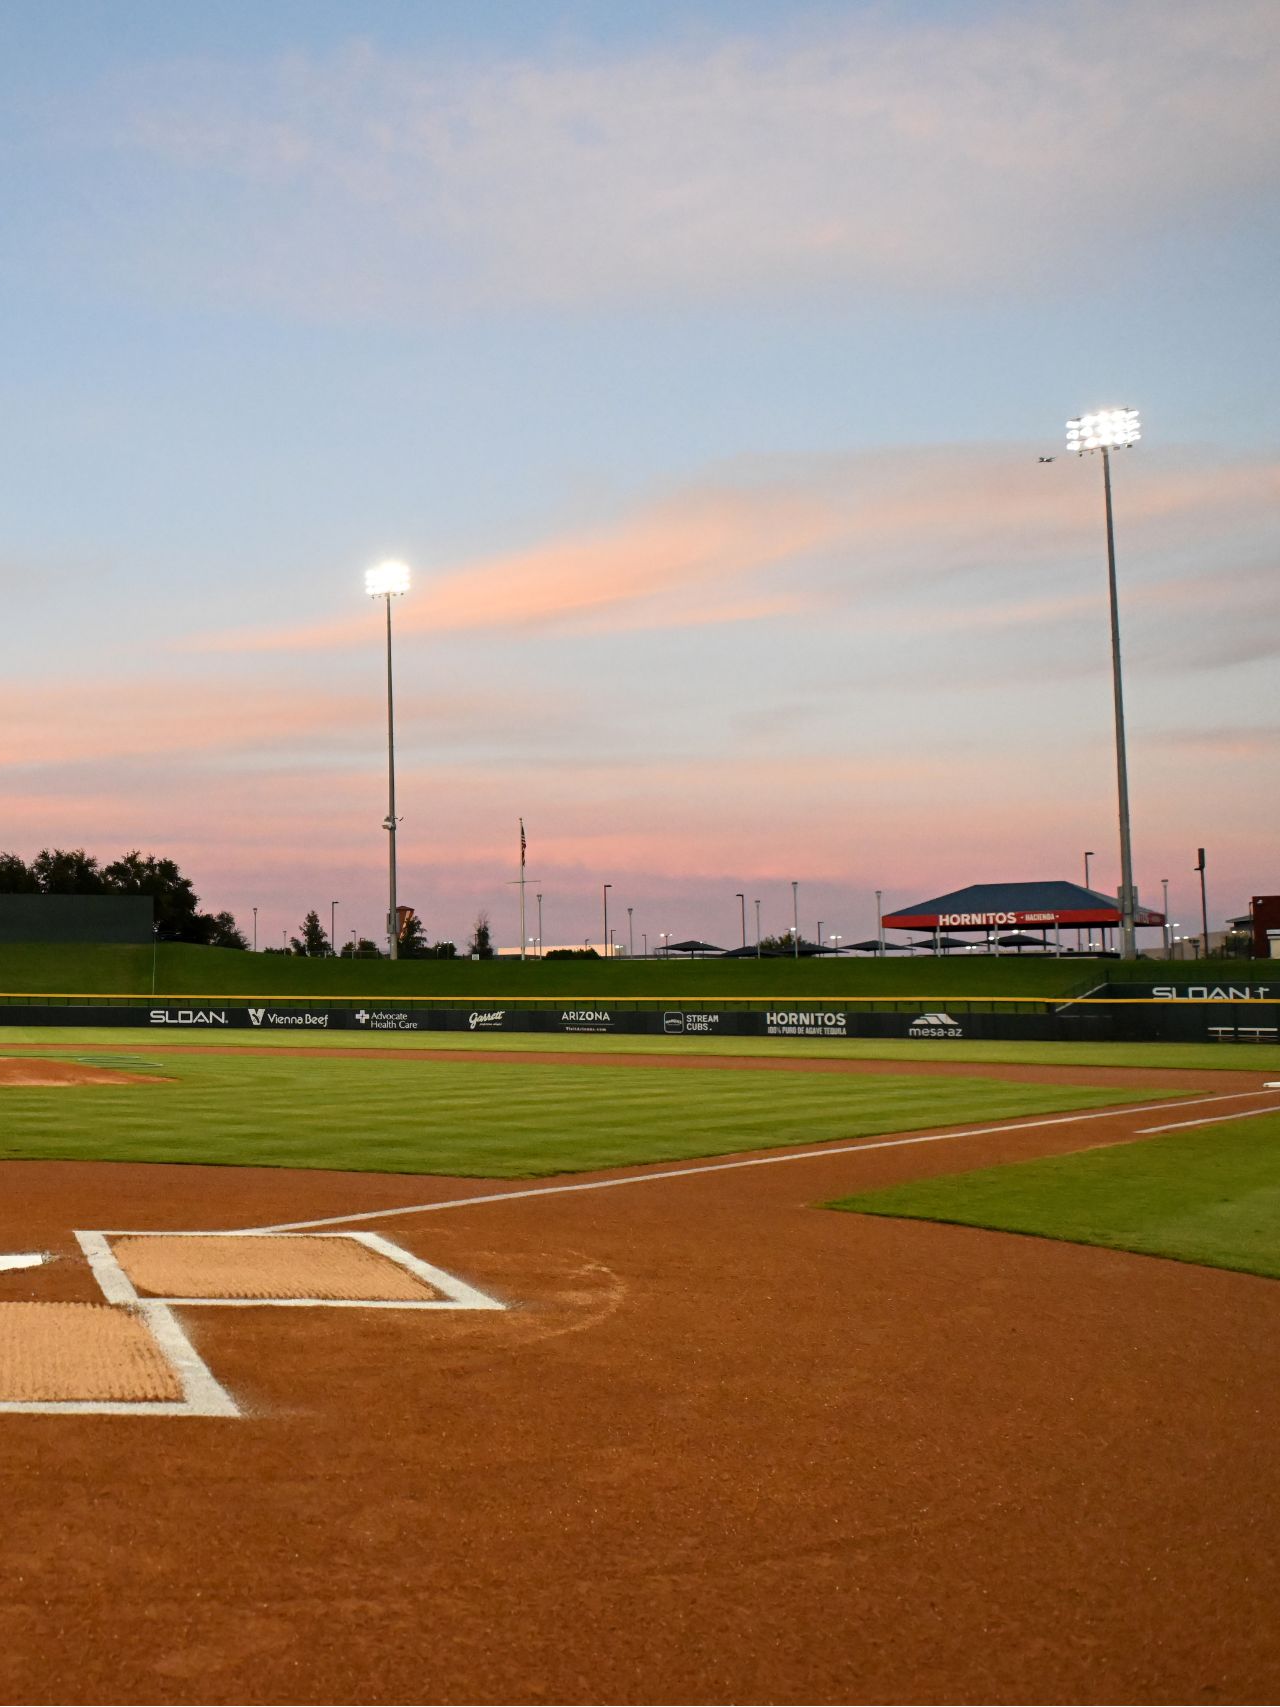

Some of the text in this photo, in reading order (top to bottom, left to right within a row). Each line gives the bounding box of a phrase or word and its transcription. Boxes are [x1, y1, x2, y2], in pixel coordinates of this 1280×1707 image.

[939, 912, 1056, 926] HORNITOS HACIENDA
[1152, 986, 1250, 1000] SLOAN
[149, 1010, 226, 1024] SLOAN
[267, 1013, 329, 1028] Vienna Beef
[371, 1012, 408, 1021] Advocate
[469, 1010, 506, 1030] Garrett
[561, 1011, 611, 1021] ARIZONA
[686, 1014, 719, 1023] STREAM
[766, 1012, 847, 1026] HORNITOS
[371, 1020, 418, 1030] Health Care
[686, 1023, 713, 1031] CUBS.
[767, 1026, 781, 1034] 100%
[781, 1026, 797, 1034] PURO
[805, 1027, 823, 1035] AGAVE
[823, 1027, 847, 1035] TEQUILA
